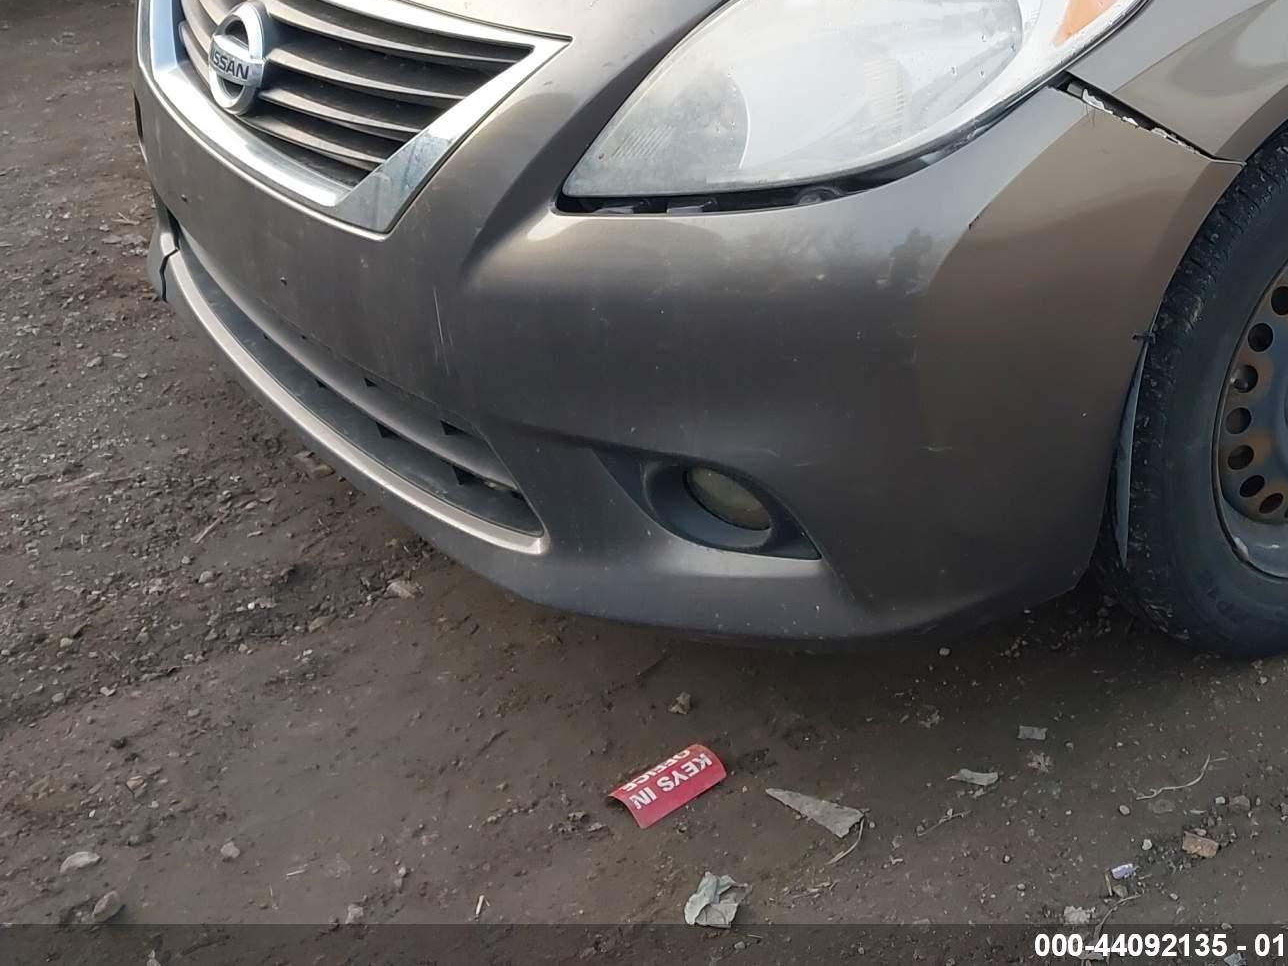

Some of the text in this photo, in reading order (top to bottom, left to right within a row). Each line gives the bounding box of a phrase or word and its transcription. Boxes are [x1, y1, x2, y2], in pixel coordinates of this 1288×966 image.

[211, 47, 249, 80] SSAN
[629, 753, 713, 810] KEYS IN
